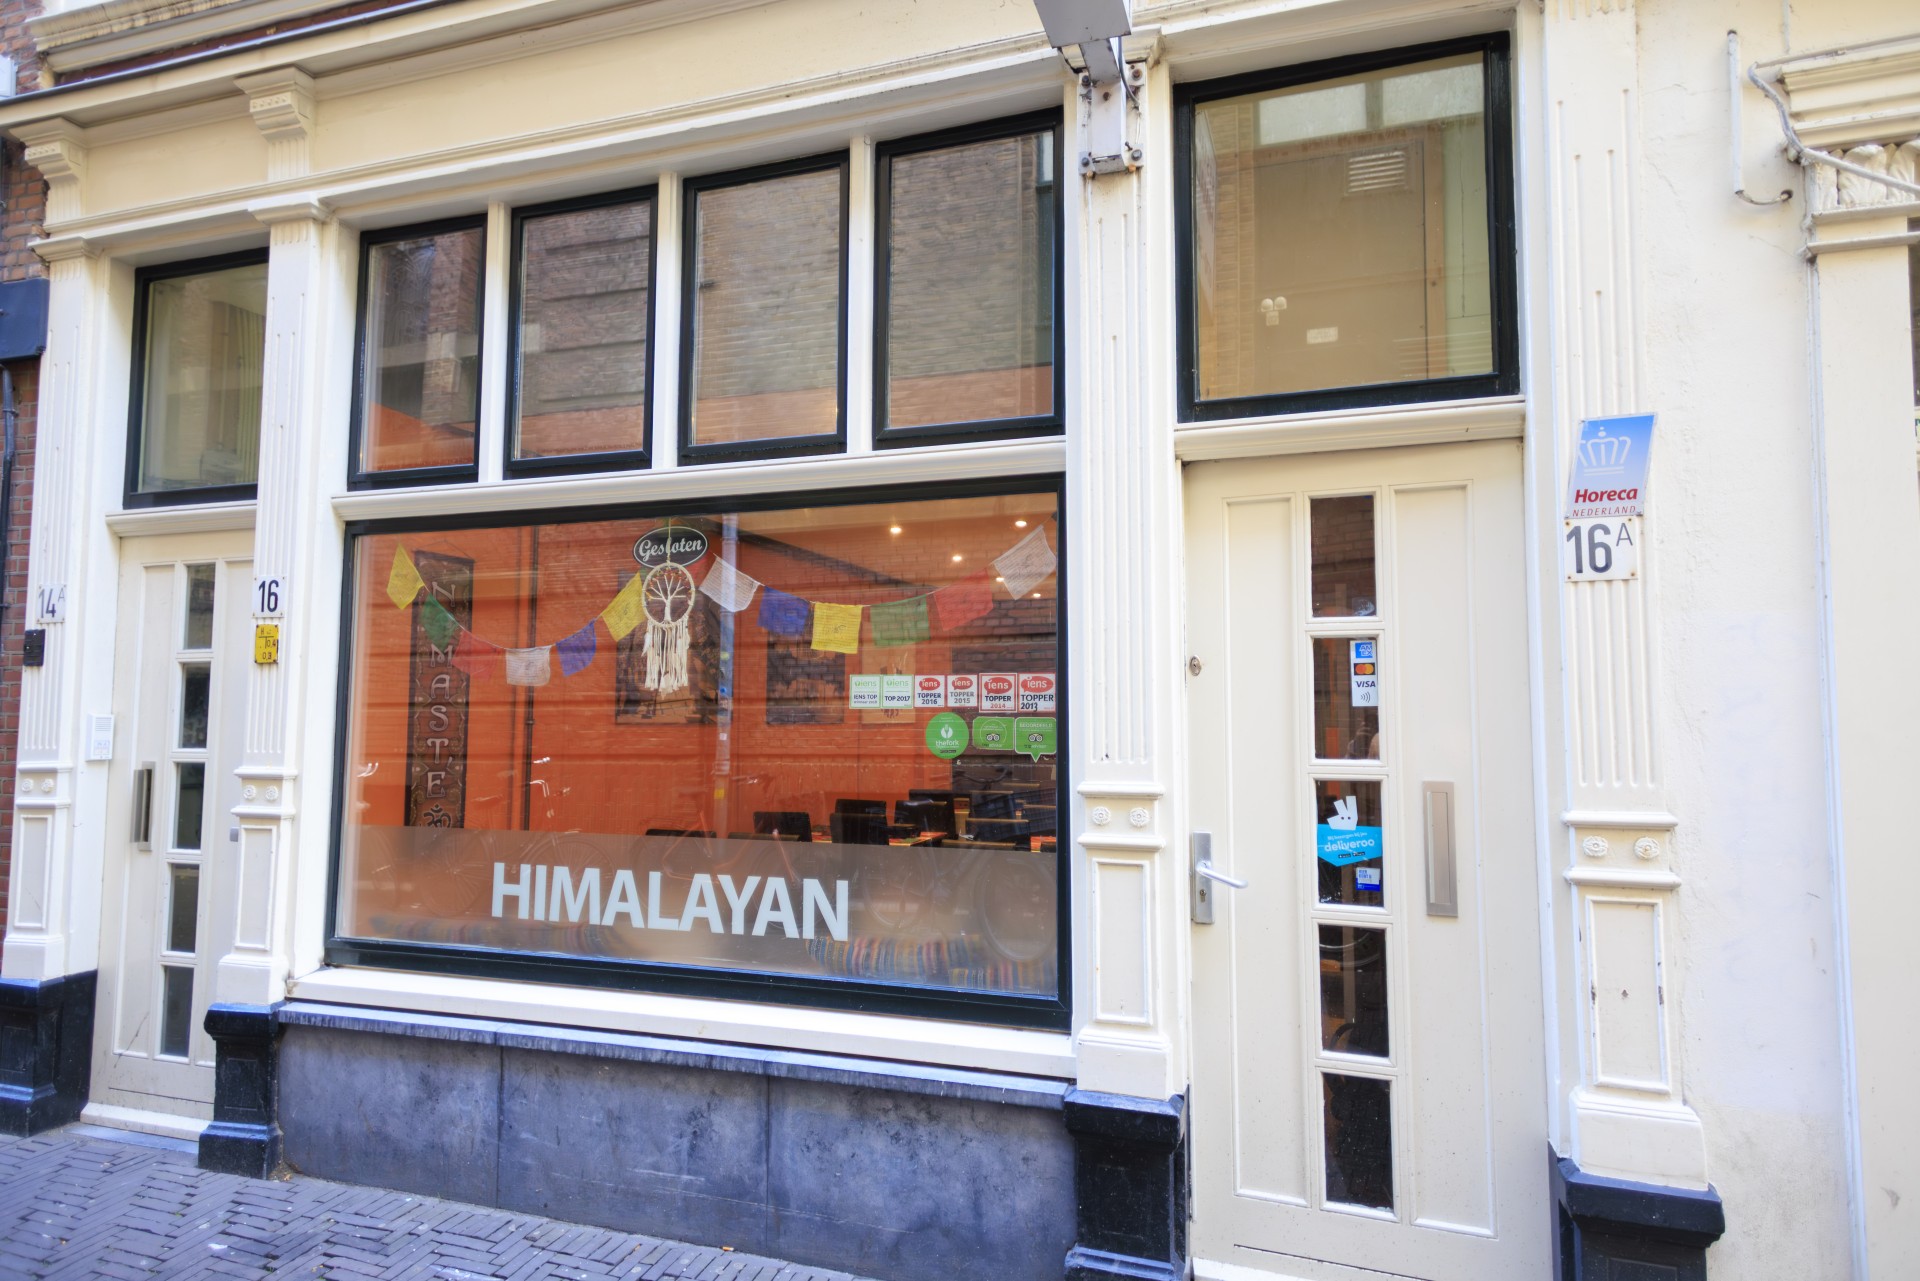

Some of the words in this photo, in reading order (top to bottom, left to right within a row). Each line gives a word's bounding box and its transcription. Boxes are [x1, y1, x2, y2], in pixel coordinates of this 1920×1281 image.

[1575, 488, 1638, 503] Horeca
[1572, 505, 1636, 517] NEDERLAND
[639, 538, 702, 562] Gesloten
[258, 579, 279, 613] 16
[922, 680, 938, 688] iens
[954, 679, 971, 687] iens
[988, 680, 1009, 690] iens
[1027, 677, 1047, 689] iens
[1020, 694, 1054, 702] TOPPER
[1020, 702, 1038, 712] 2013
[1324, 839, 1375, 851] deliveroo
[491, 862, 849, 941] HIMALAYAN
